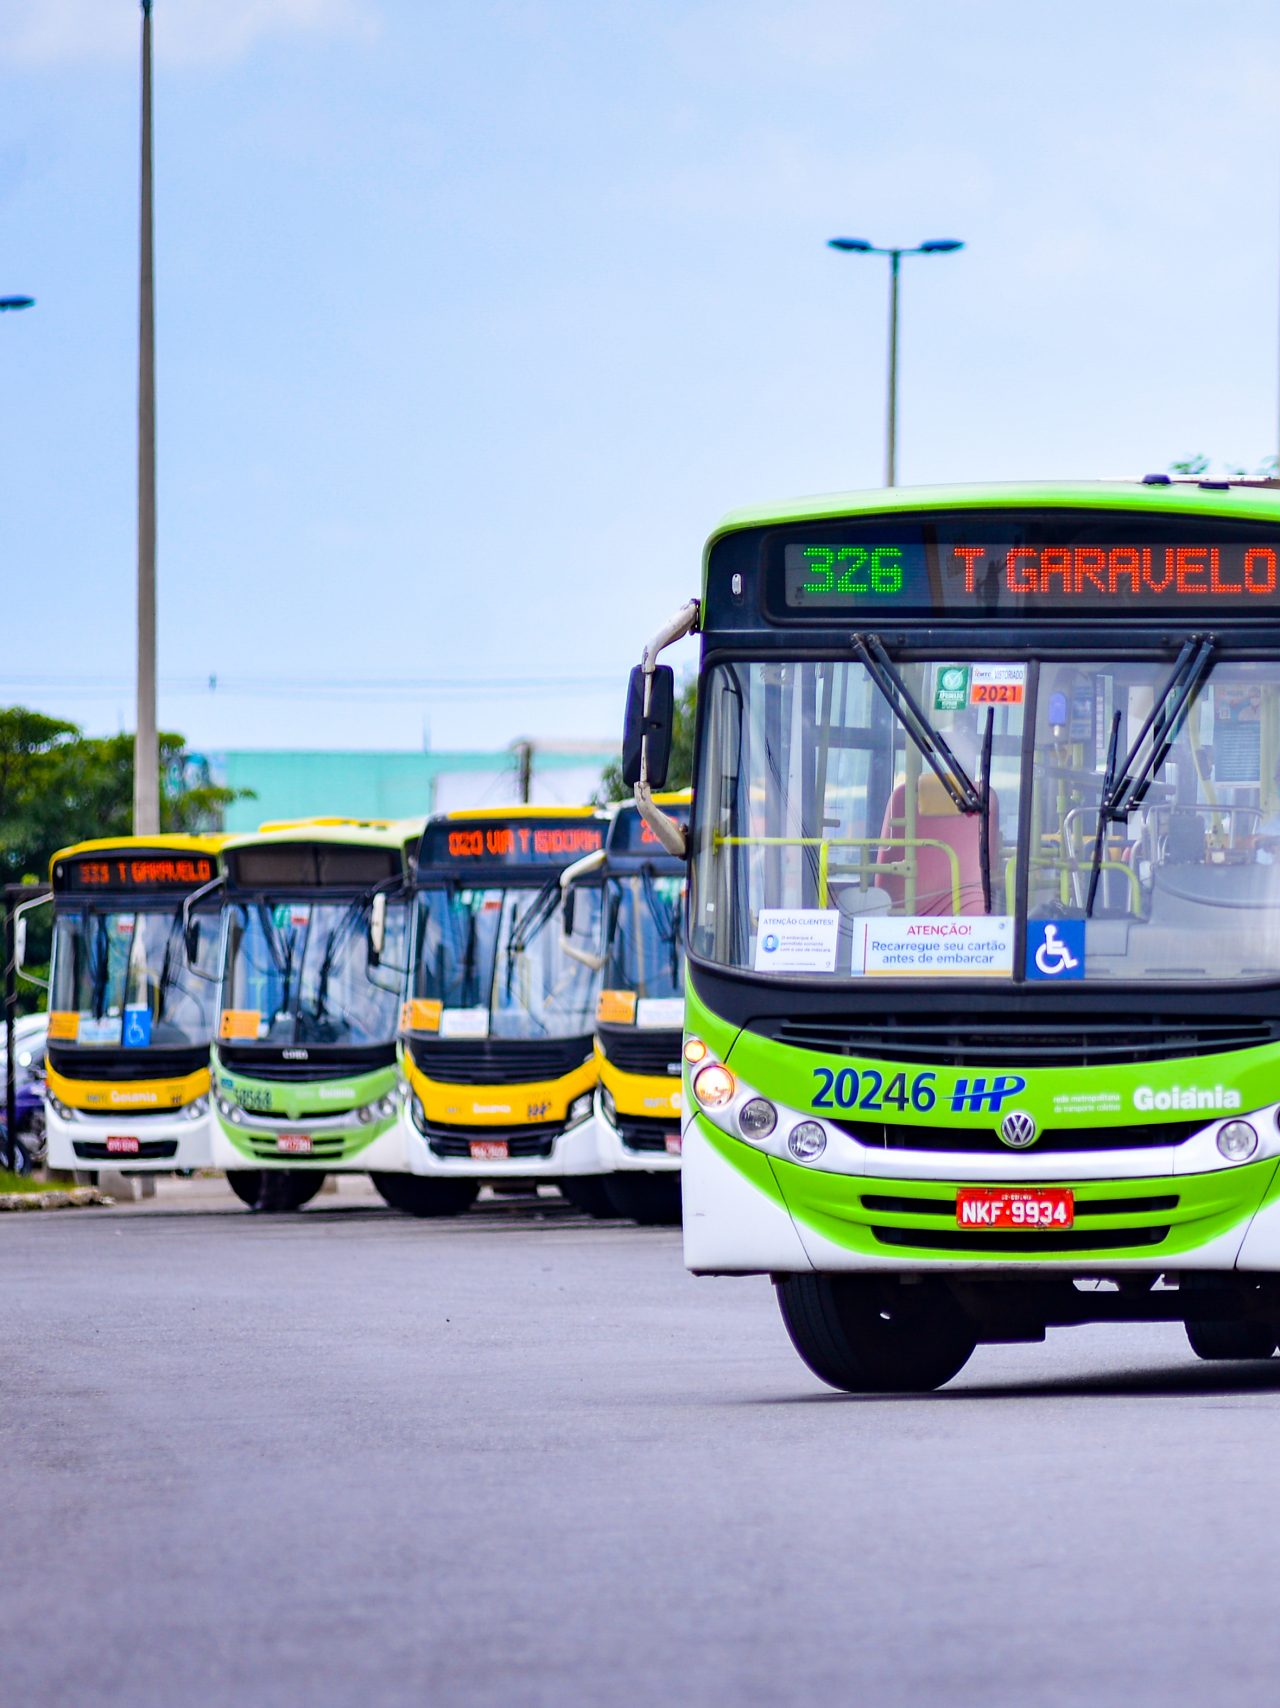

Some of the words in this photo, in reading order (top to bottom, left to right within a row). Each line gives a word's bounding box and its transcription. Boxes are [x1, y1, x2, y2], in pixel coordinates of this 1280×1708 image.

[804, 547, 903, 592] 326
[954, 547, 985, 592] T
[1007, 547, 1278, 593] GARAVELO
[978, 685, 1017, 702] 2021
[906, 923, 972, 937] ATENÇÃO!
[871, 941, 941, 953] Recarregue
[943, 942, 964, 951] seu
[967, 940, 1006, 951] cartão
[882, 955, 915, 964] antes
[918, 953, 933, 964] de
[936, 953, 995, 964] embarcar
[811, 1068, 936, 1113] 20246
